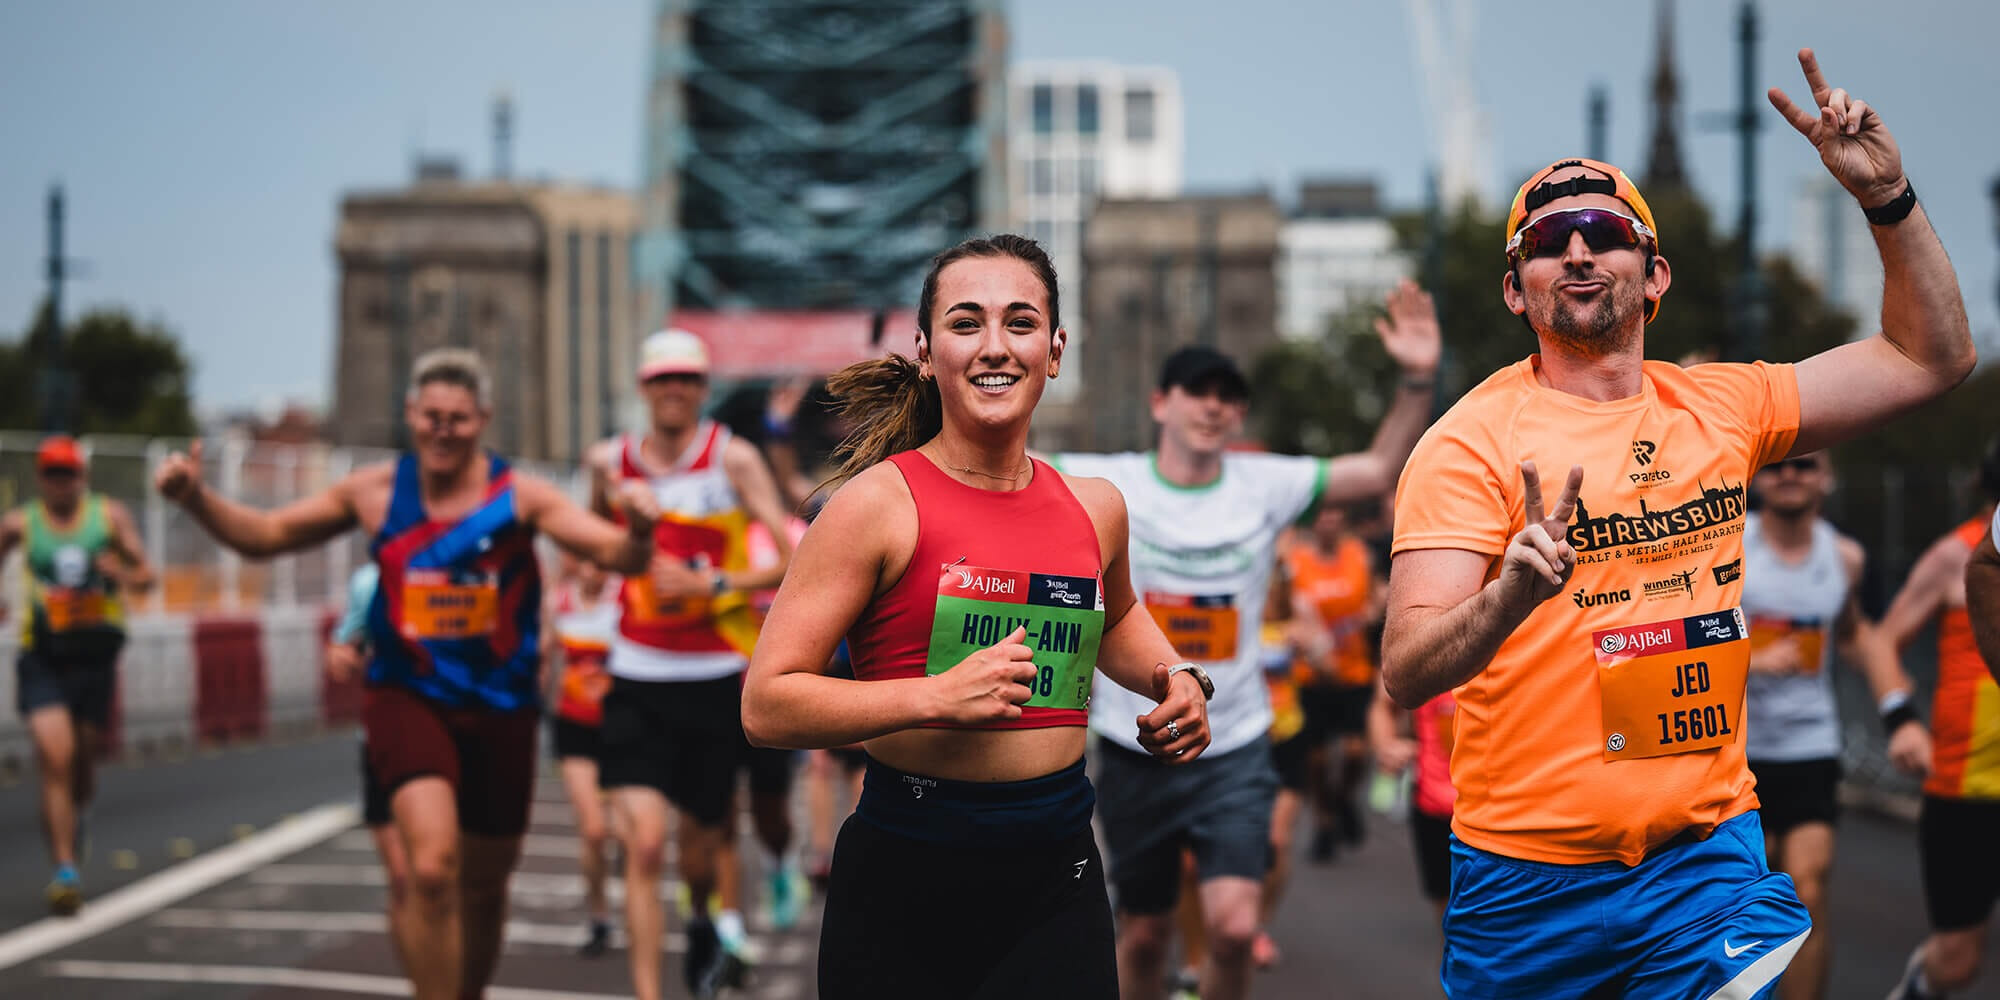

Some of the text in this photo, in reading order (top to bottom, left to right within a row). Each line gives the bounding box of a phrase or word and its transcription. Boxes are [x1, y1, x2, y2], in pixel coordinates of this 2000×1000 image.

[1629, 469, 1671, 483] Pareto
[1571, 494, 1744, 551] SHREWSBURY
[1577, 551, 1612, 565] HALF
[1615, 550, 1623, 560] &
[1627, 542, 1669, 557] METRIC
[1673, 534, 1700, 548] HALF
[1651, 552, 1672, 563] MILES
[1691, 543, 1714, 554] MILES
[1644, 577, 1683, 590] winner
[1572, 588, 1632, 609] Runna
[1671, 661, 1711, 698] JED
[1657, 703, 1732, 745] 15601
